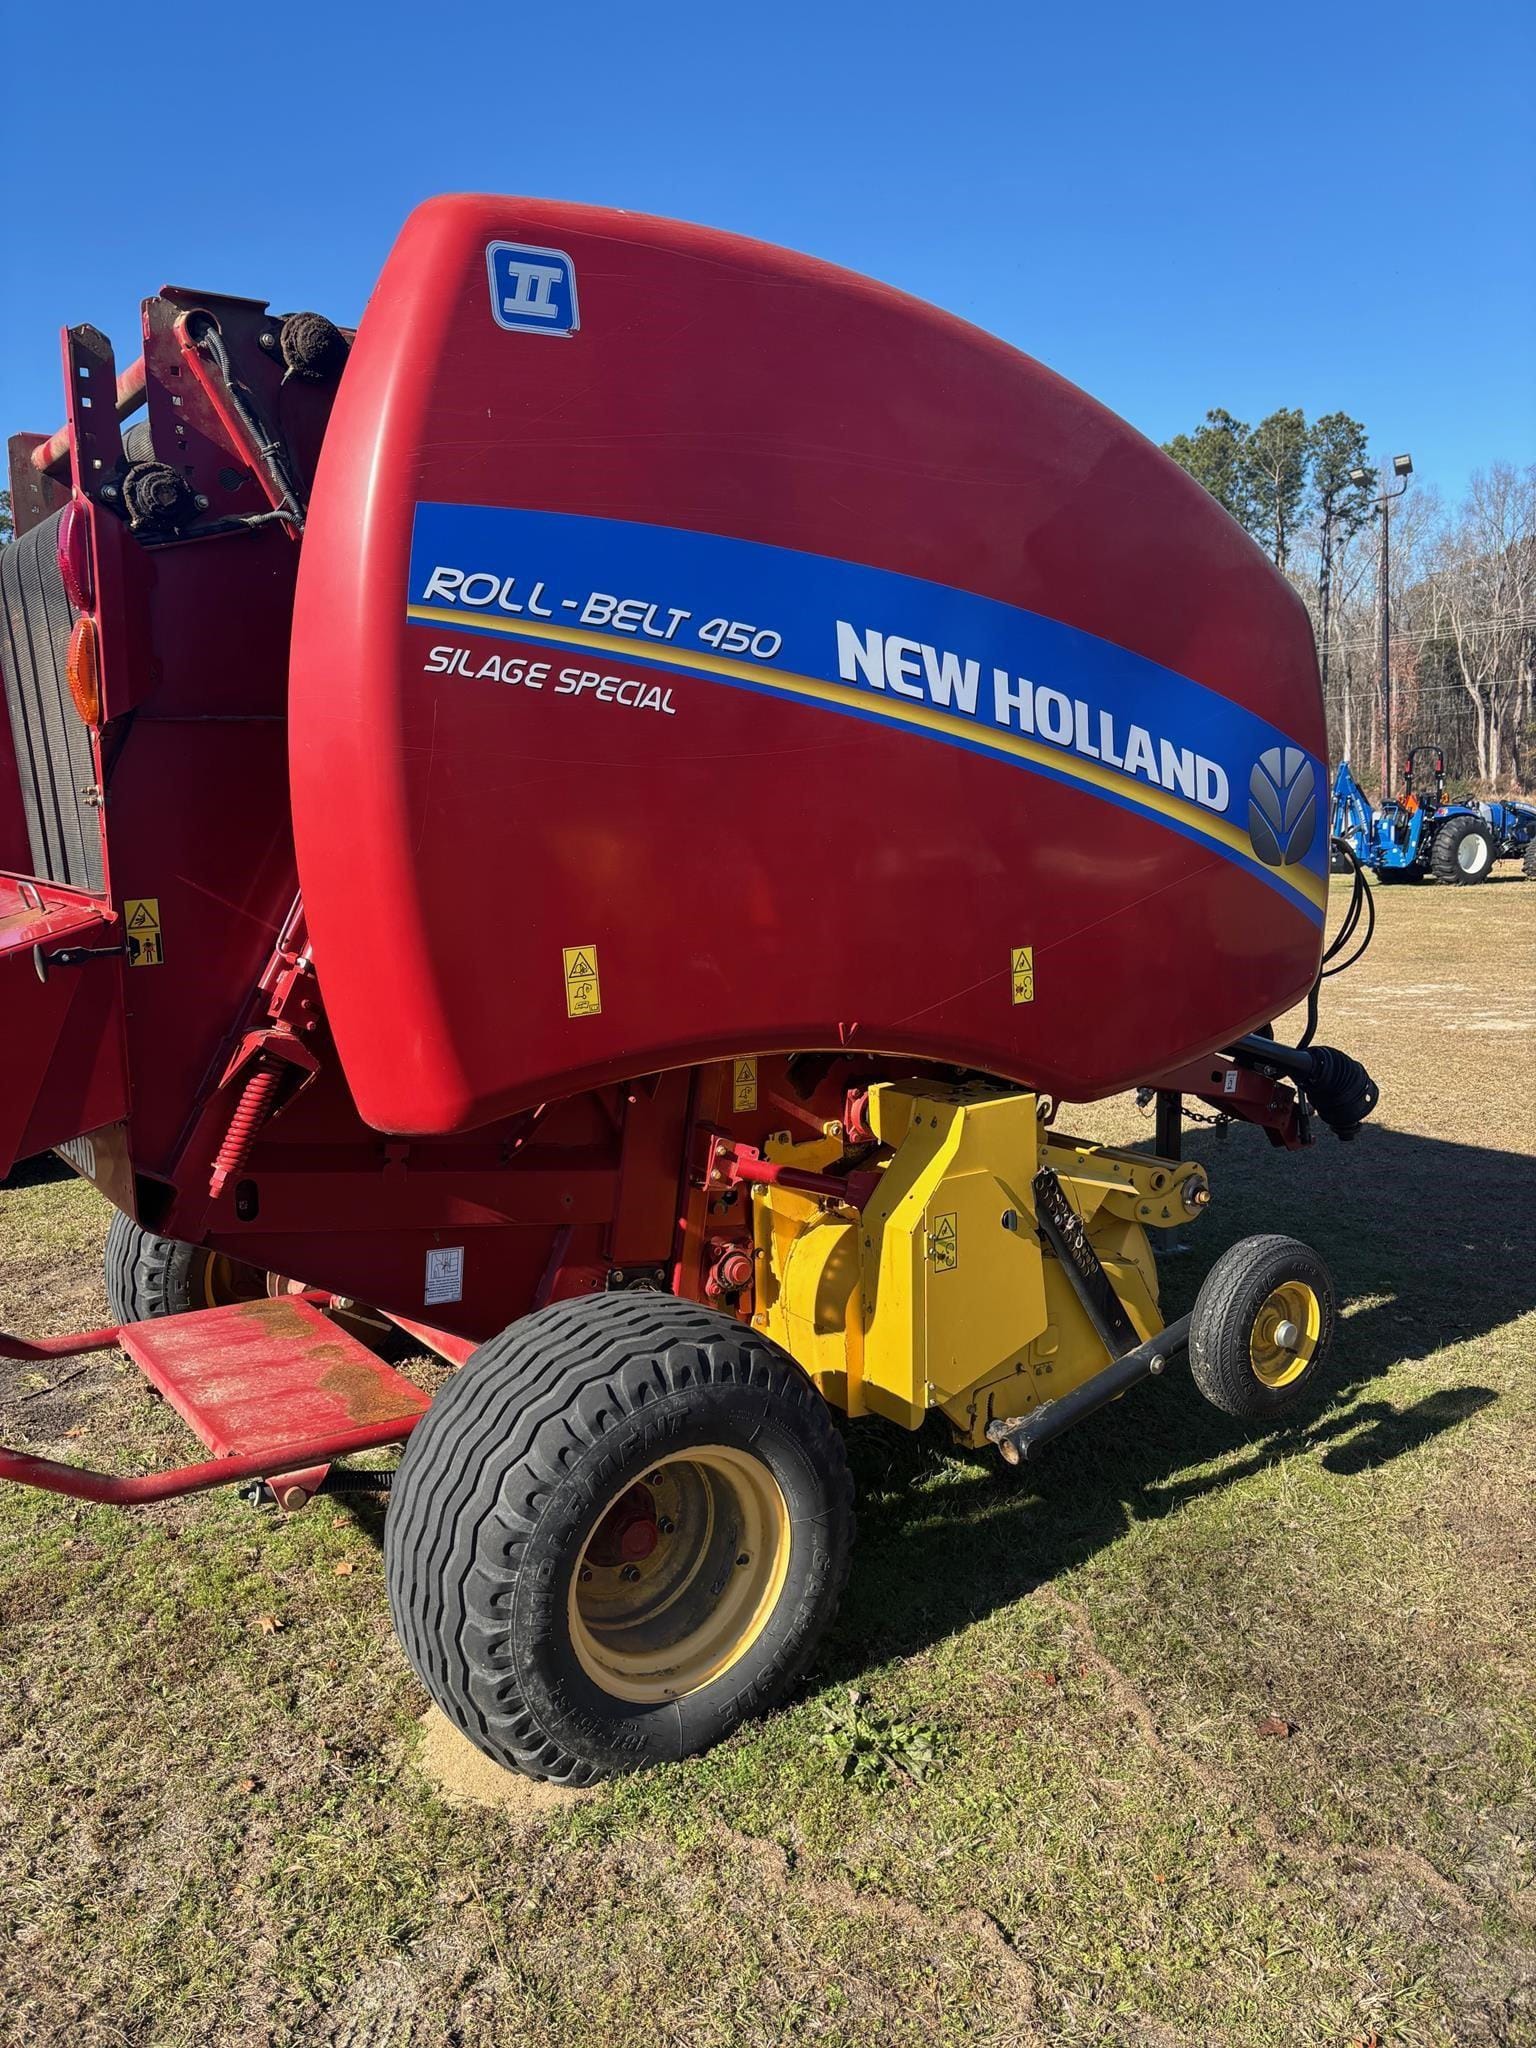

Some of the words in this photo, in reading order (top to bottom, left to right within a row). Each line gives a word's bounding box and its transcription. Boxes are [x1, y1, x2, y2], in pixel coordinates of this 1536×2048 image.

[503, 261, 563, 318] II
[698, 618, 782, 659] 450
[424, 646, 551, 689] SILAGE
[555, 668, 677, 714] SPECIAL
[836, 620, 980, 715] NEW
[993, 667, 1230, 812] HOLLAND
